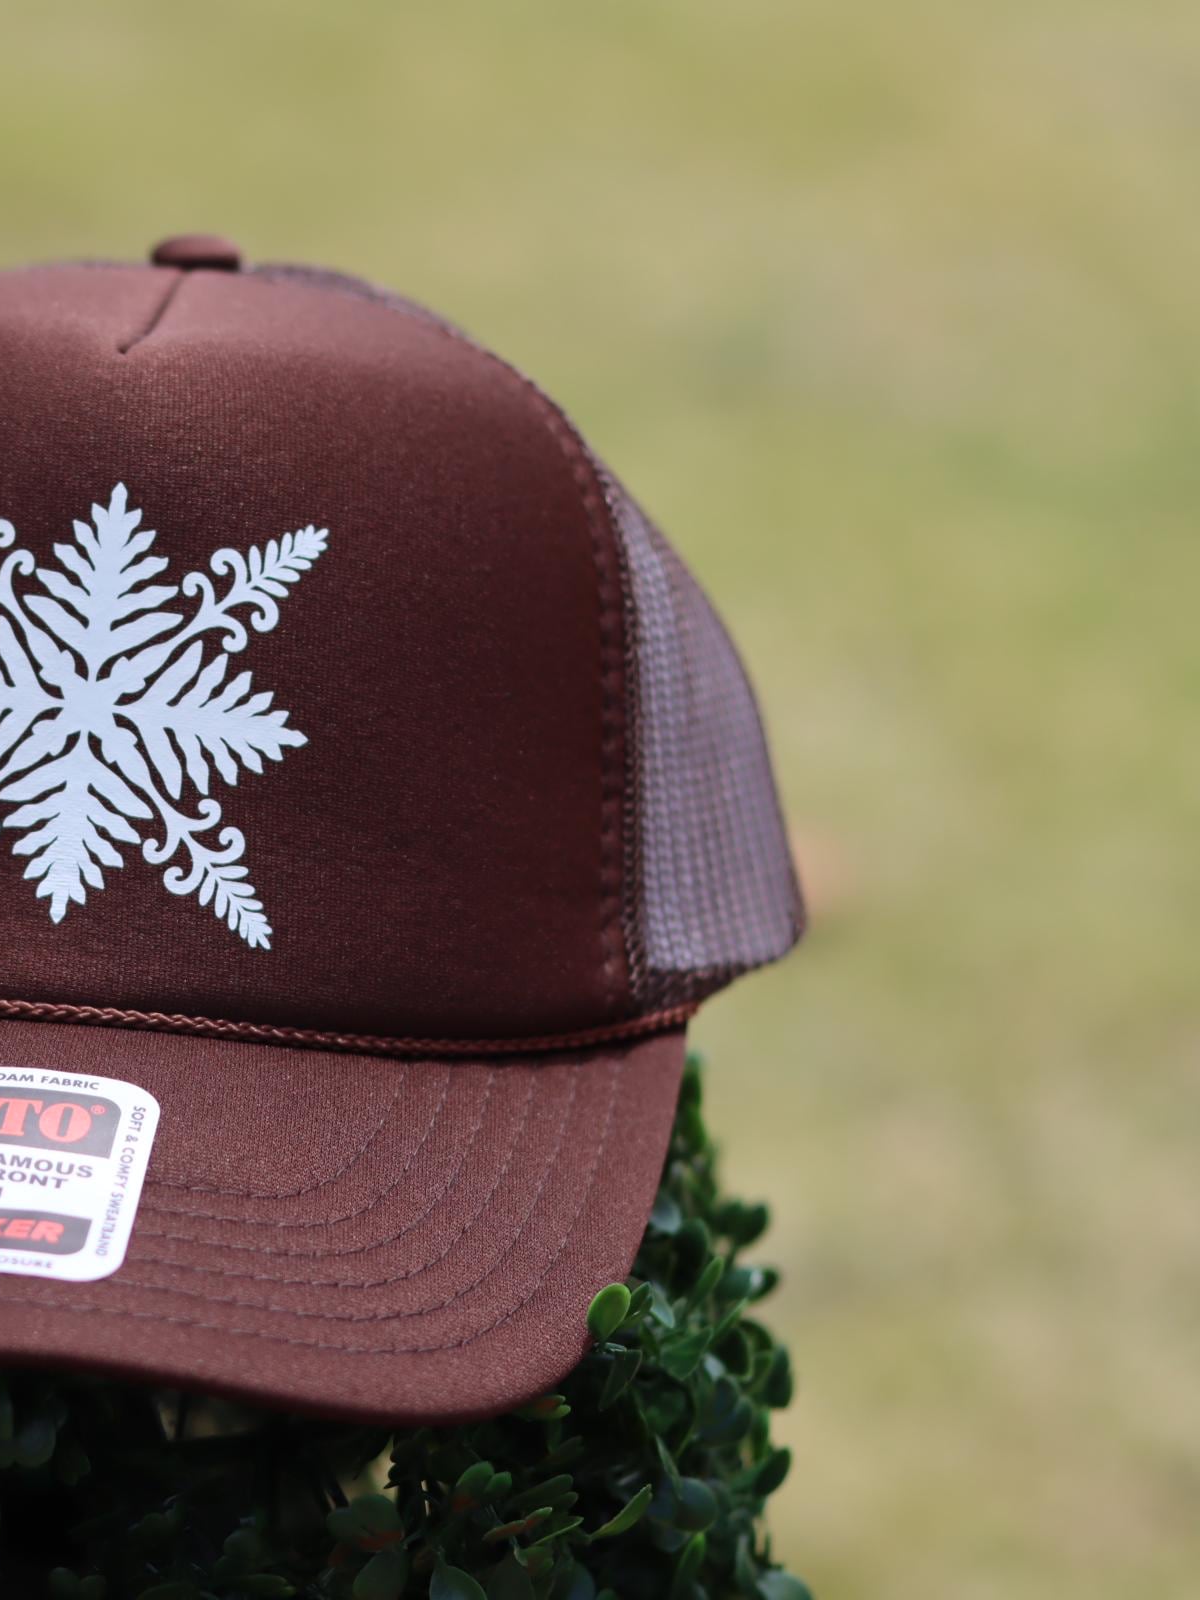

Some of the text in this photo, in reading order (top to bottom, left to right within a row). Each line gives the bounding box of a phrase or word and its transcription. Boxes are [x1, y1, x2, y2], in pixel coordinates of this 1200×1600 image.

[40, 1076, 100, 1091] FABRIC
[131, 1105, 147, 1133] SOFT
[124, 1134, 139, 1144] &
[116, 1146, 135, 1188] COMFY
